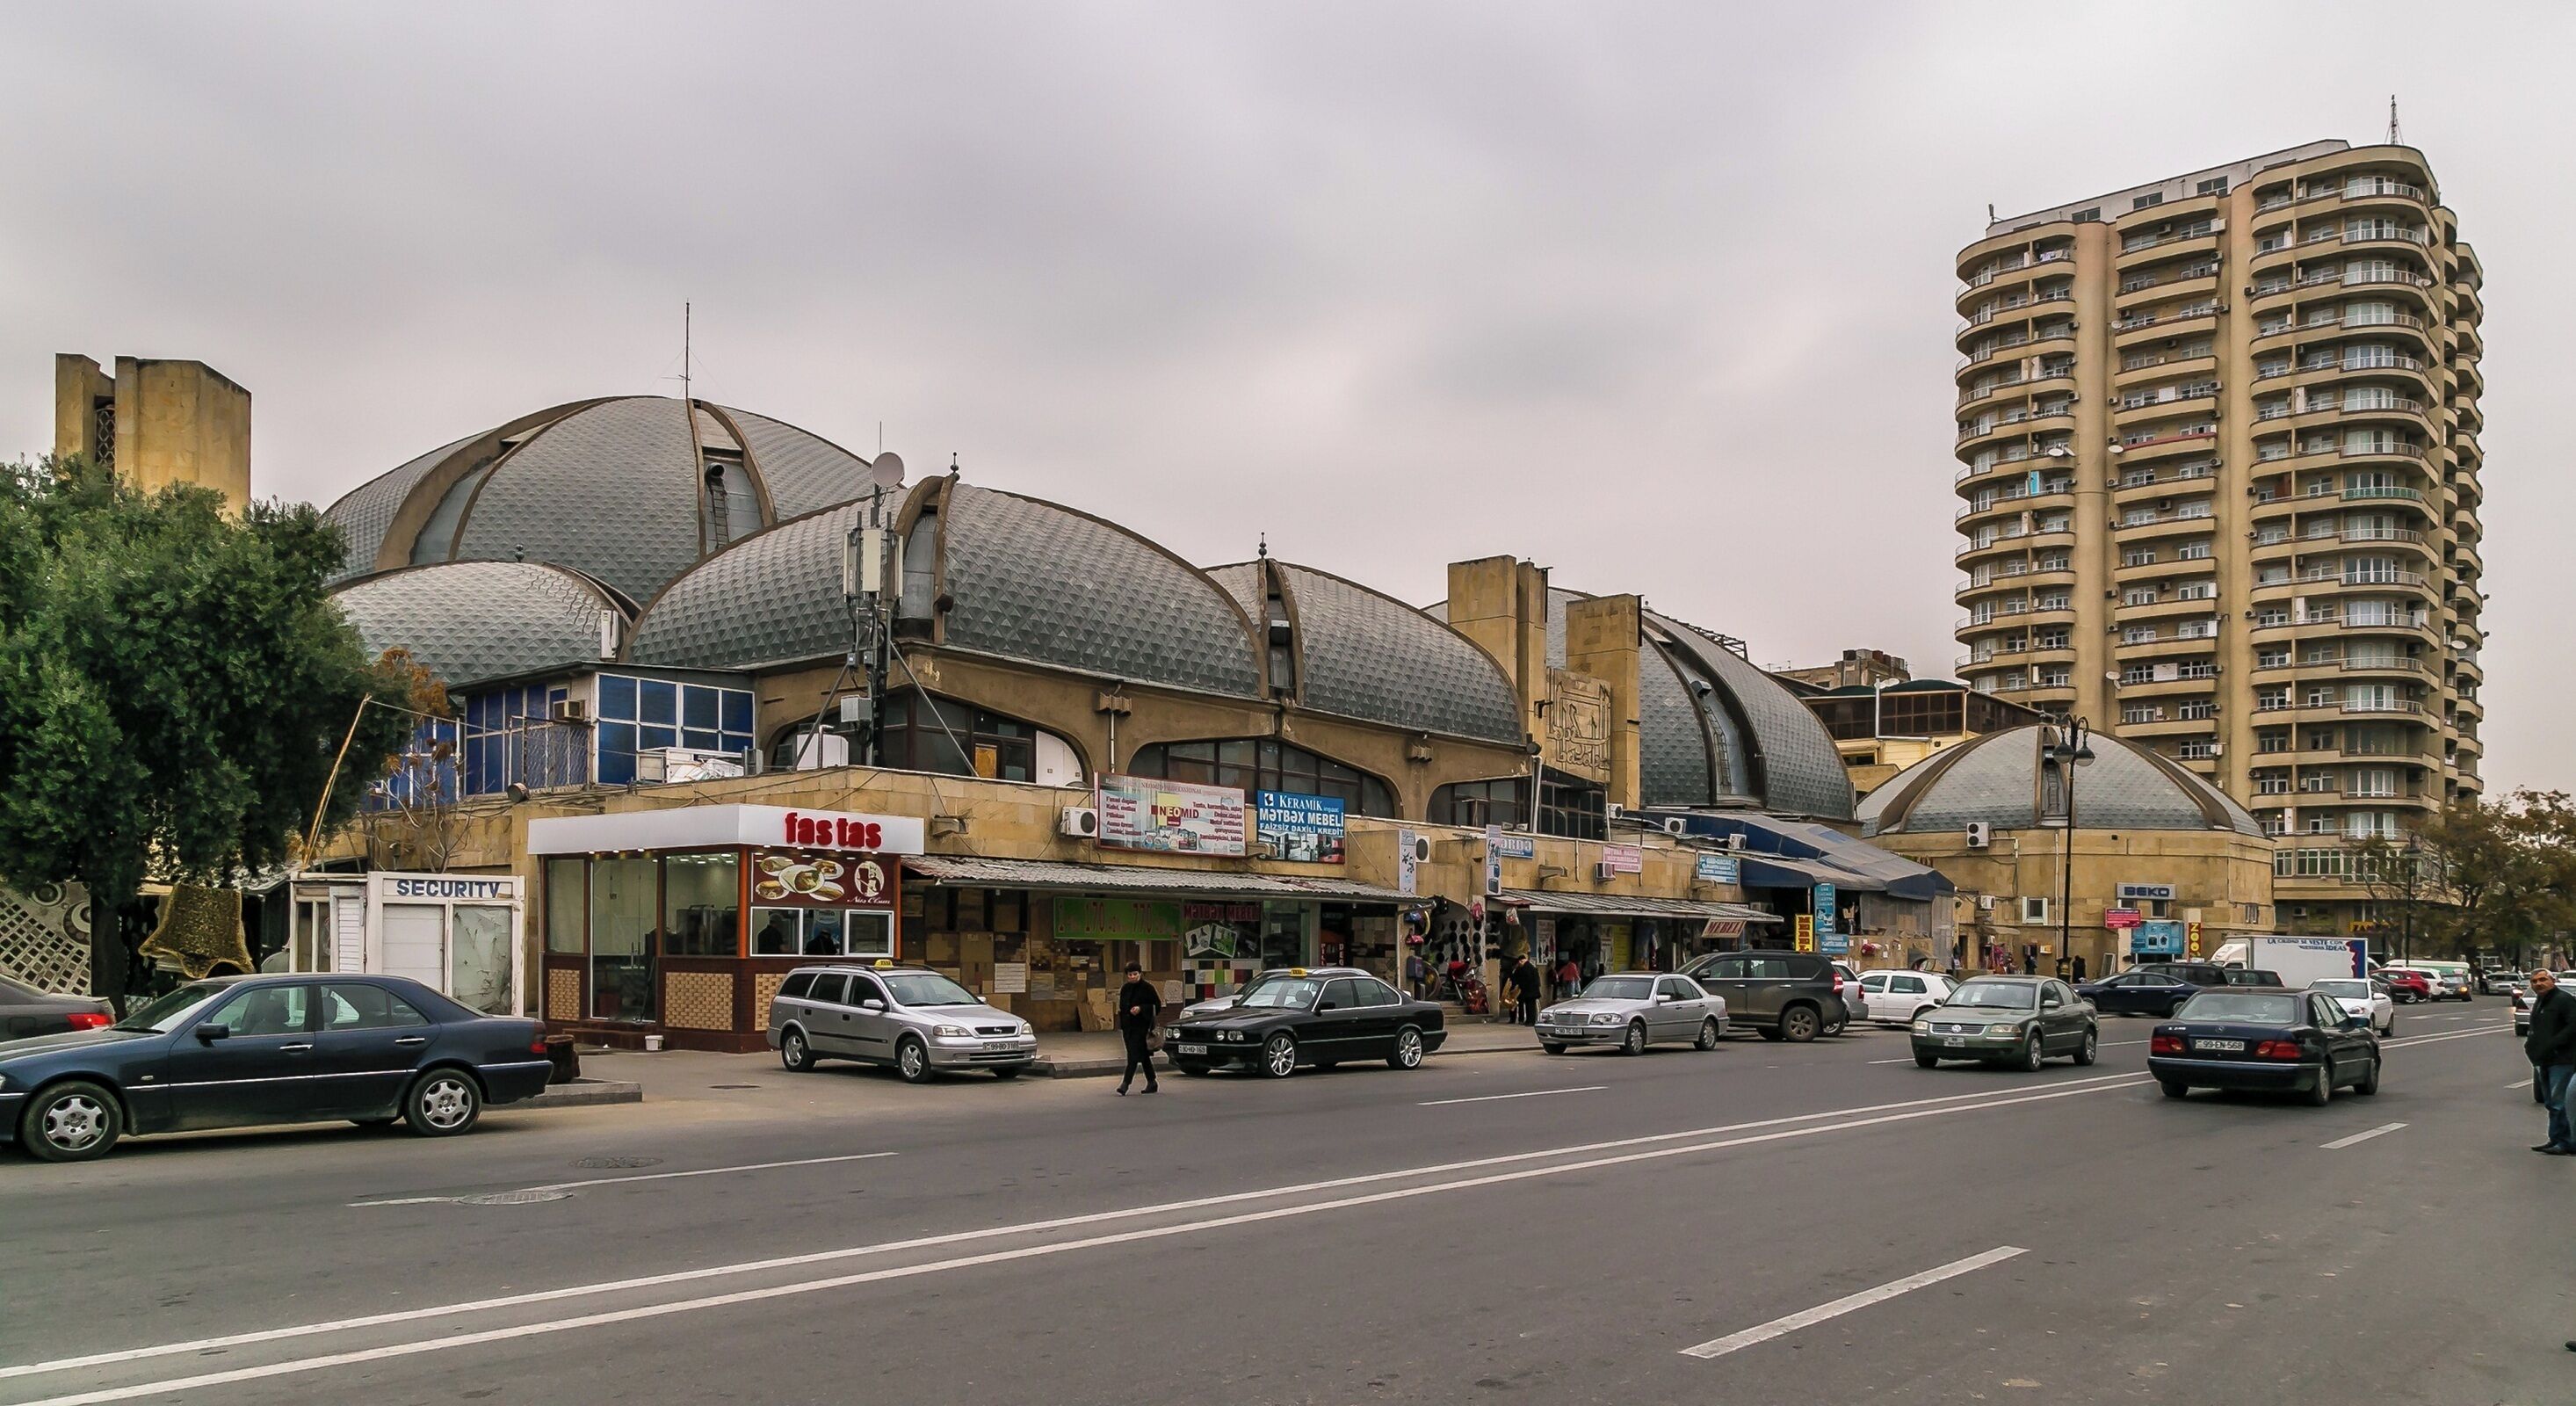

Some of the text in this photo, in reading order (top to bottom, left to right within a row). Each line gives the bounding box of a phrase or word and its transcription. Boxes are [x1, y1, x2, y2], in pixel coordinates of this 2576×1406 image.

[1160, 806, 1199, 819] NEOMID
[1259, 808, 1305, 824] MƏTBƏX
[2124, 886, 2170, 896] BEKO
[2190, 923, 2200, 952] ZOO
